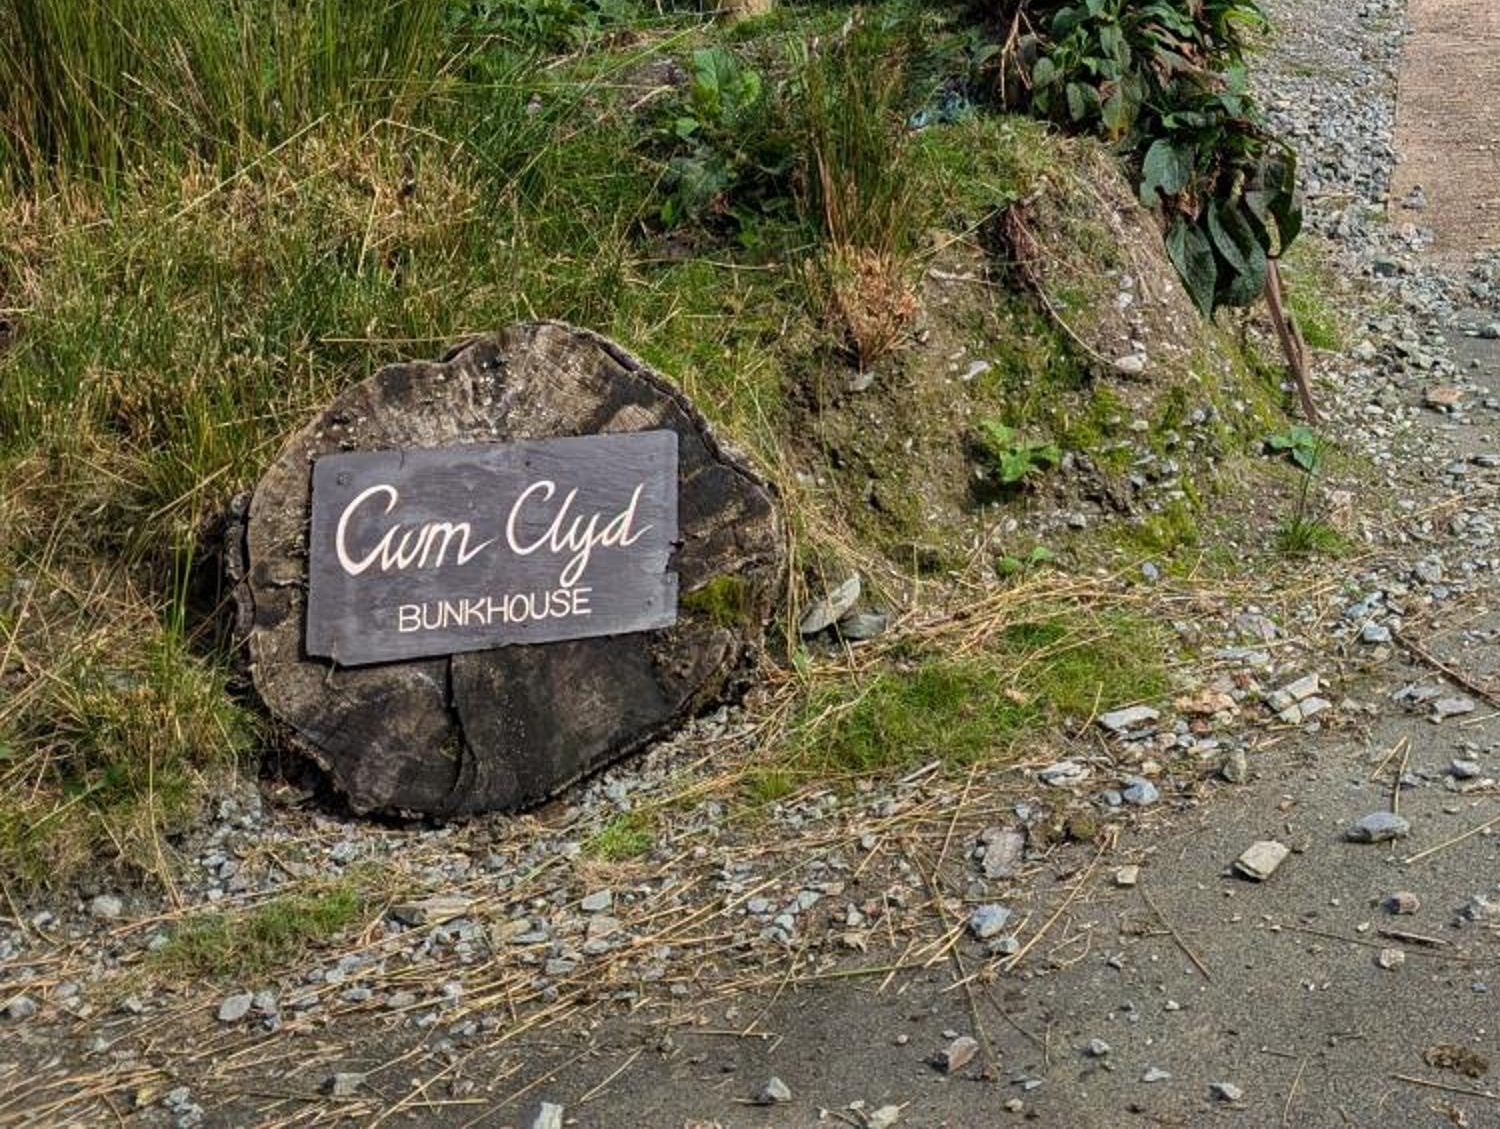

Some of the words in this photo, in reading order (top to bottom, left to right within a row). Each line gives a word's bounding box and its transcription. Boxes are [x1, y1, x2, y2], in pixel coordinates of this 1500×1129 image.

[335, 483, 496, 576] Cwm
[505, 479, 654, 589] Clyd
[398, 586, 593, 633] BUNKHOUSE
